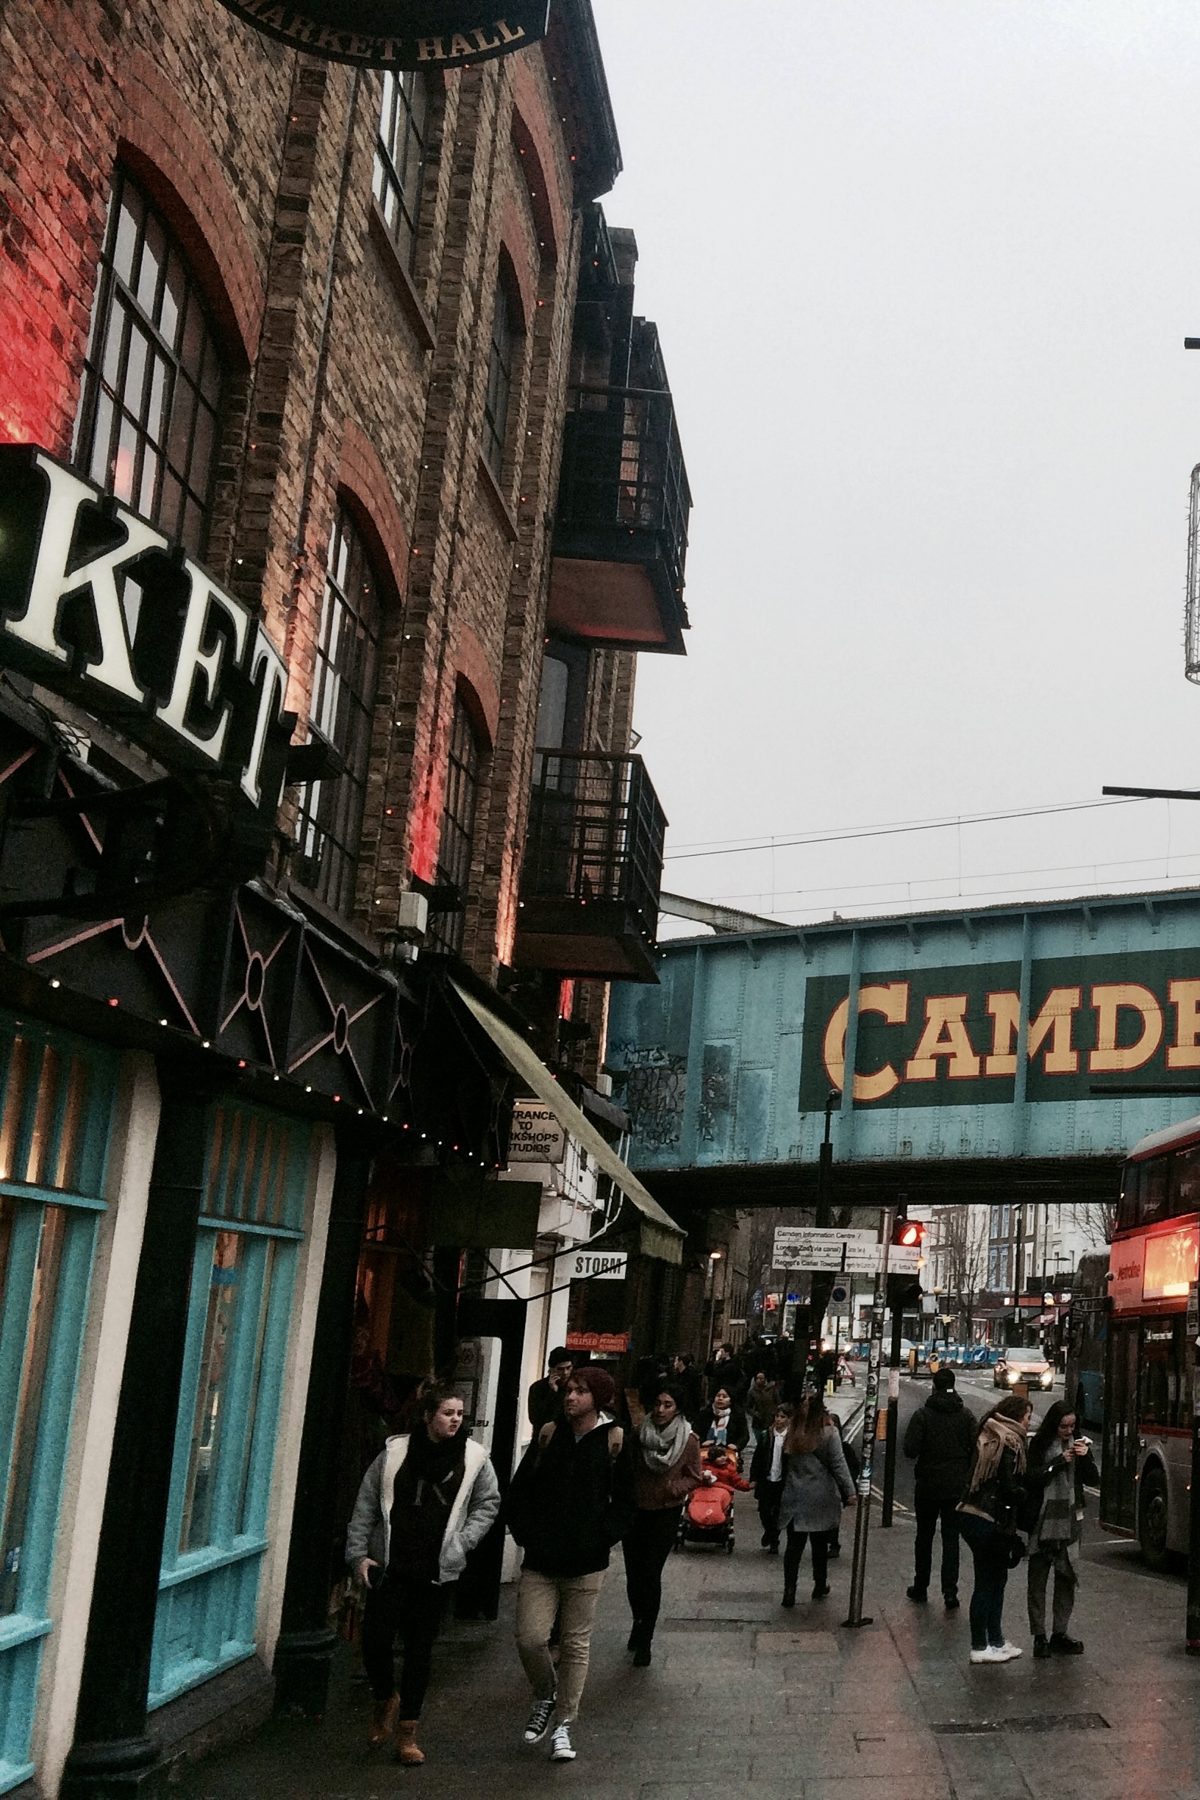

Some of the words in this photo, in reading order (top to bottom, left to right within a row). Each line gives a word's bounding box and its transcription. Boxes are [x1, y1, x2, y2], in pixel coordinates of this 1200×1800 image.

[415, 19, 525, 61] HALL
[5, 453, 289, 808] KET
[518, 1121, 533, 1131] TO
[575, 1257, 622, 1274] STORM
